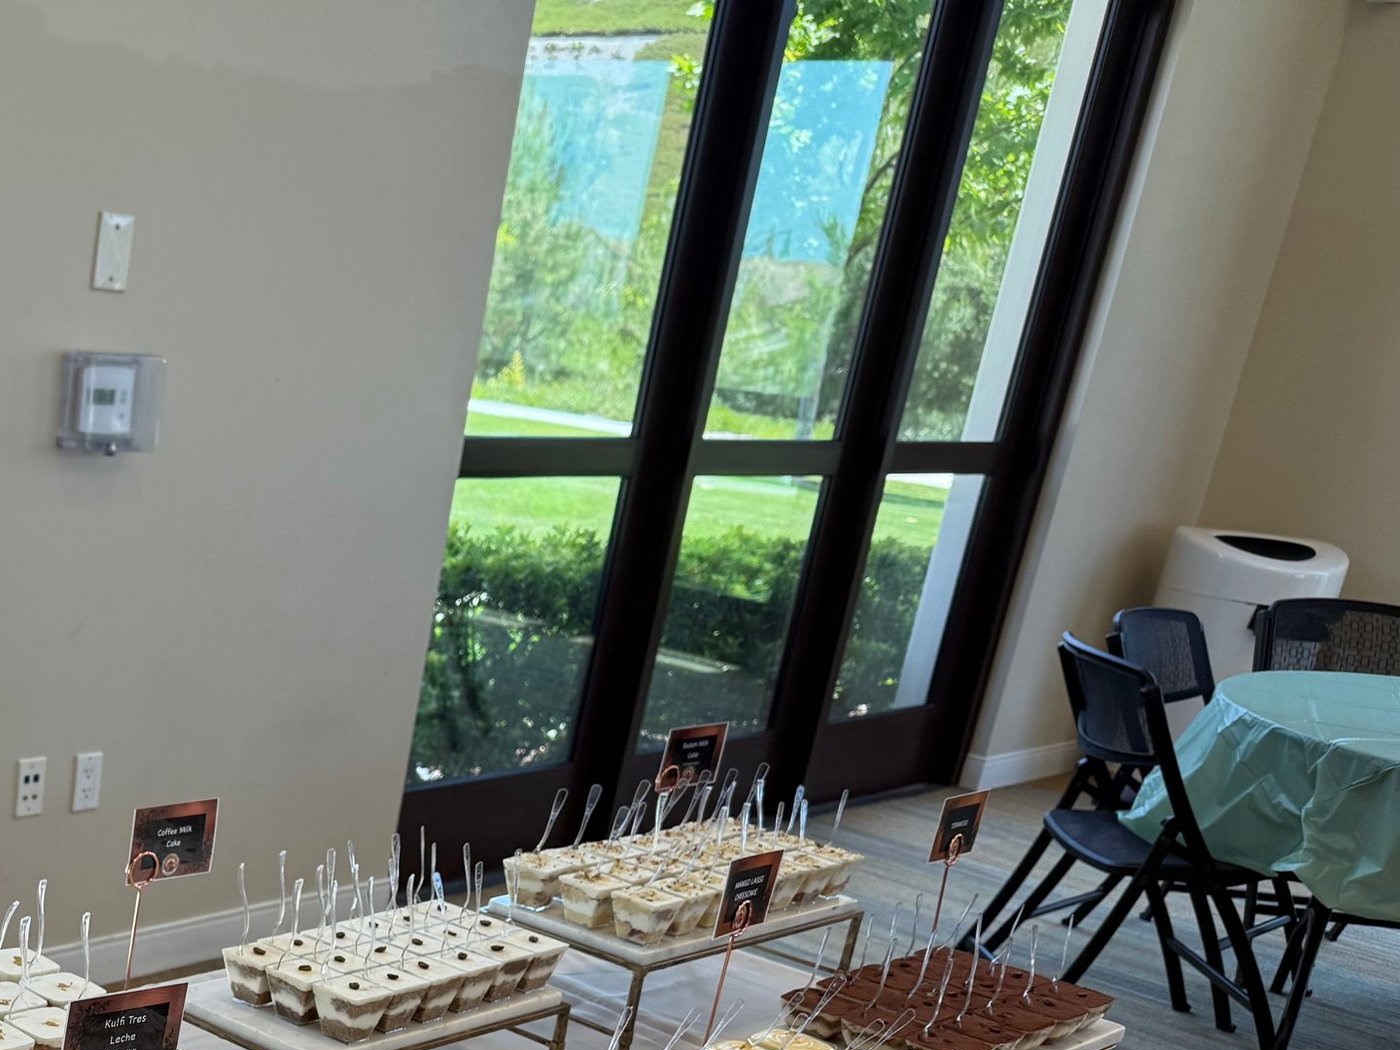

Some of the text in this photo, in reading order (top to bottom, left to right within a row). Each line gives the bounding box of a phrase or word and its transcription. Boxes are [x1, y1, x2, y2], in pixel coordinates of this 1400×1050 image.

[157, 825, 192, 837] Coffee Milk
[166, 839, 181, 848] Cake
[104, 1014, 147, 1029] Kulfi Tres
[110, 1033, 136, 1045] Leche
